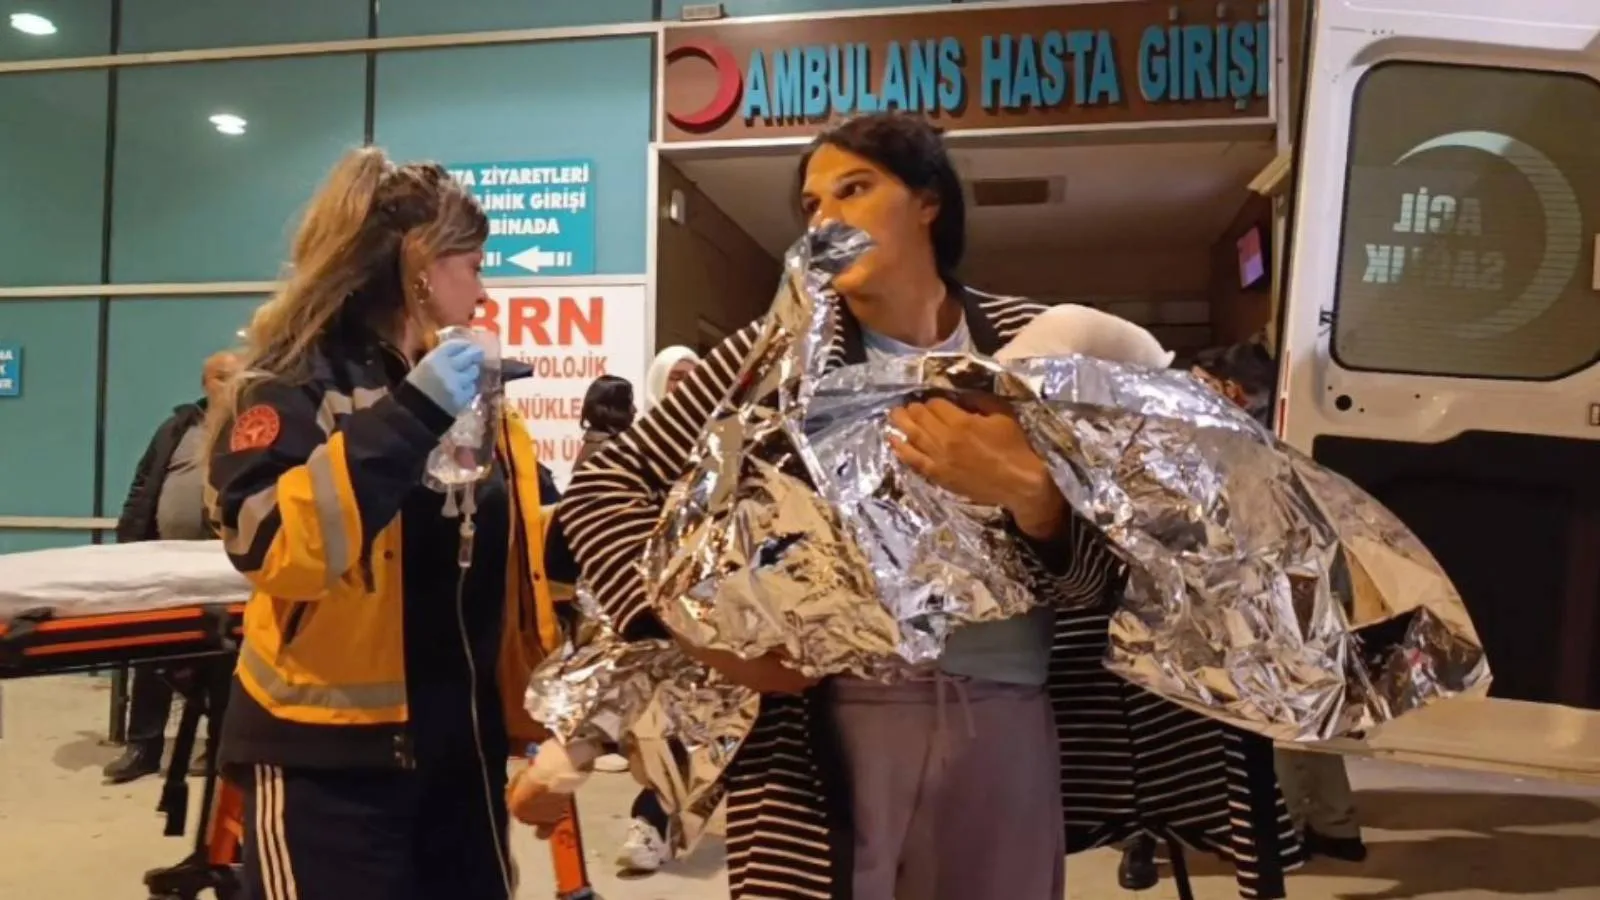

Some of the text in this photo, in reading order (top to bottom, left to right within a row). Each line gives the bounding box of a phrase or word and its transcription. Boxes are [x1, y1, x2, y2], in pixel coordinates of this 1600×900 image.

[742, 2, 1268, 120] AMBULANS HASTA GİRİŞİ
[480, 163, 590, 186] ZİYARETLERİ
[529, 187, 586, 214] GİRİŞİ
[488, 213, 560, 235] BİNADA
[518, 393, 582, 420] NÜKLE
